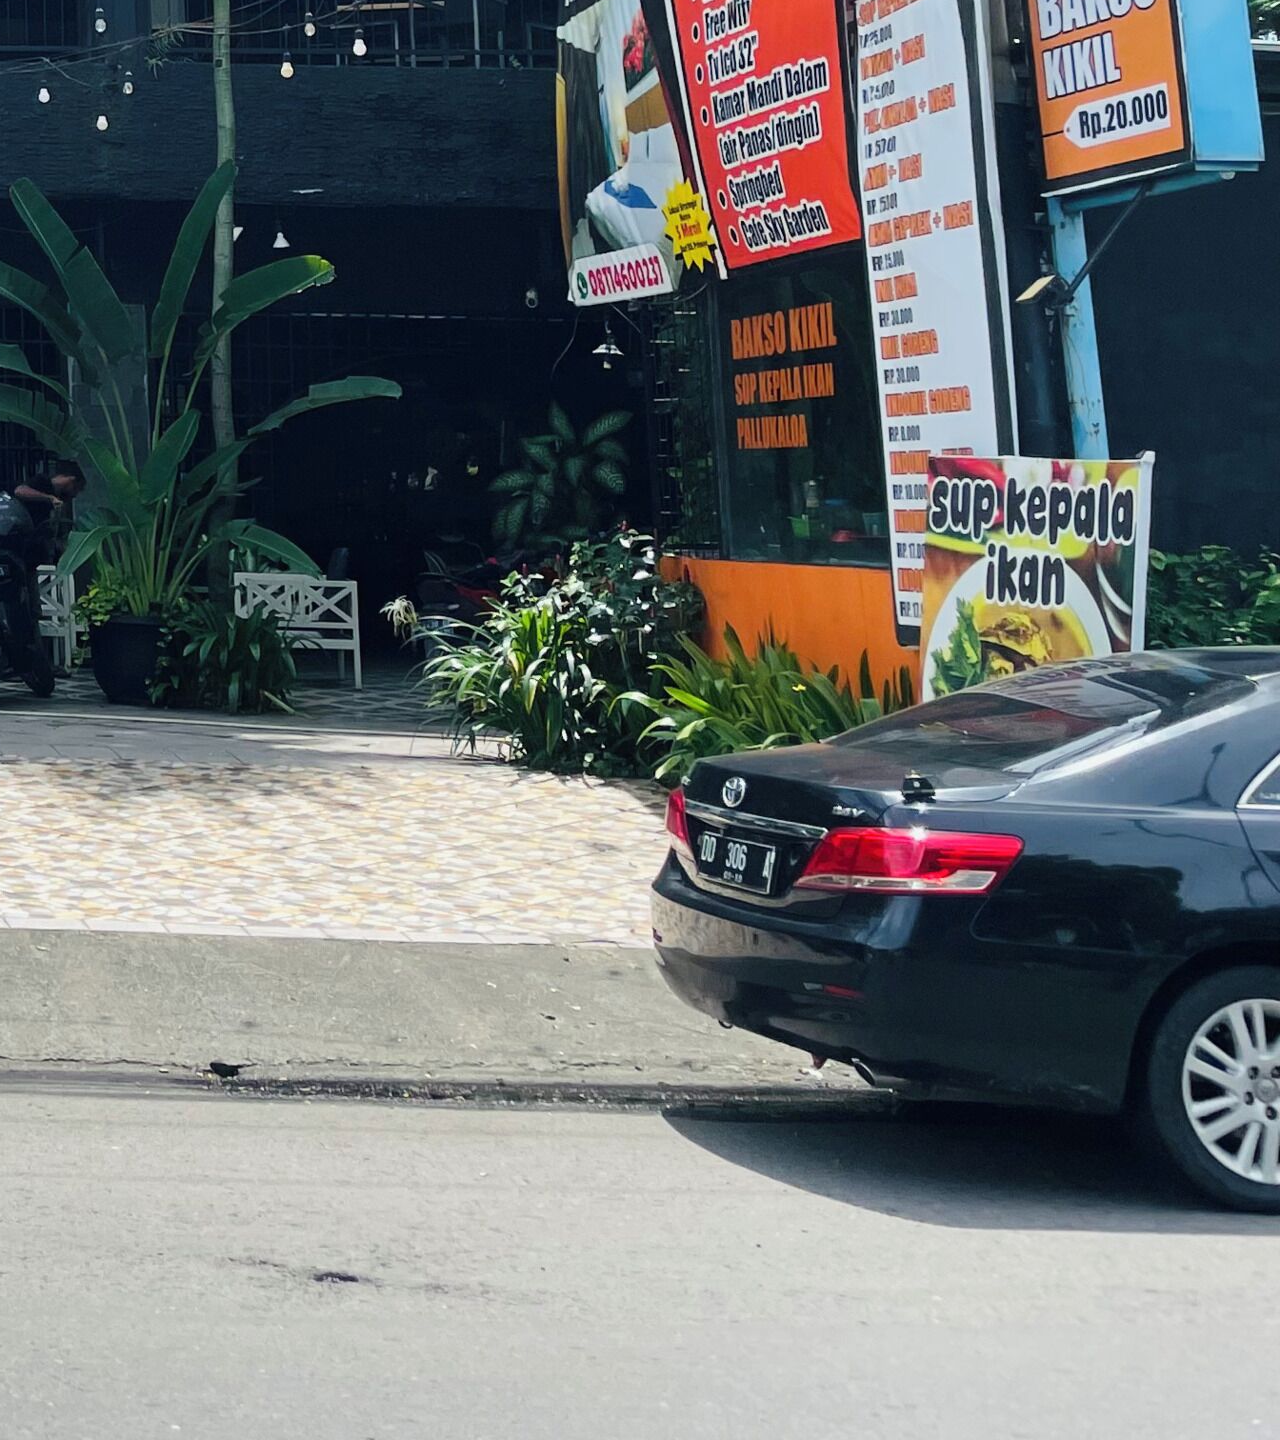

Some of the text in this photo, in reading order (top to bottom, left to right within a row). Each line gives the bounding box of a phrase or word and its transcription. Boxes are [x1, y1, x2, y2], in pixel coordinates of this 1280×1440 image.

[705, 10, 726, 40] Free
[1042, 30, 1122, 101] KIKIL
[712, 90, 746, 124] Kamar
[746, 72, 784, 111] Mandi
[784, 61, 828, 98] Dalam
[1079, 90, 1168, 140] Rp.20.000
[719, 134, 739, 165] (air
[729, 164, 783, 209] Springbed
[740, 217, 768, 249] Cafe
[763, 213, 787, 243] Sky
[783, 203, 829, 238] Garden
[731, 302, 837, 360] BAKSO KIKIL
[735, 362, 835, 405] SOP KEPALA IKAN
[736, 414, 808, 449] PALLUKALOA
[931, 478, 1135, 545] sup kepala
[985, 543, 1066, 606] ikan
[701, 833, 716, 864] DD
[725, 838, 747, 870] 306
